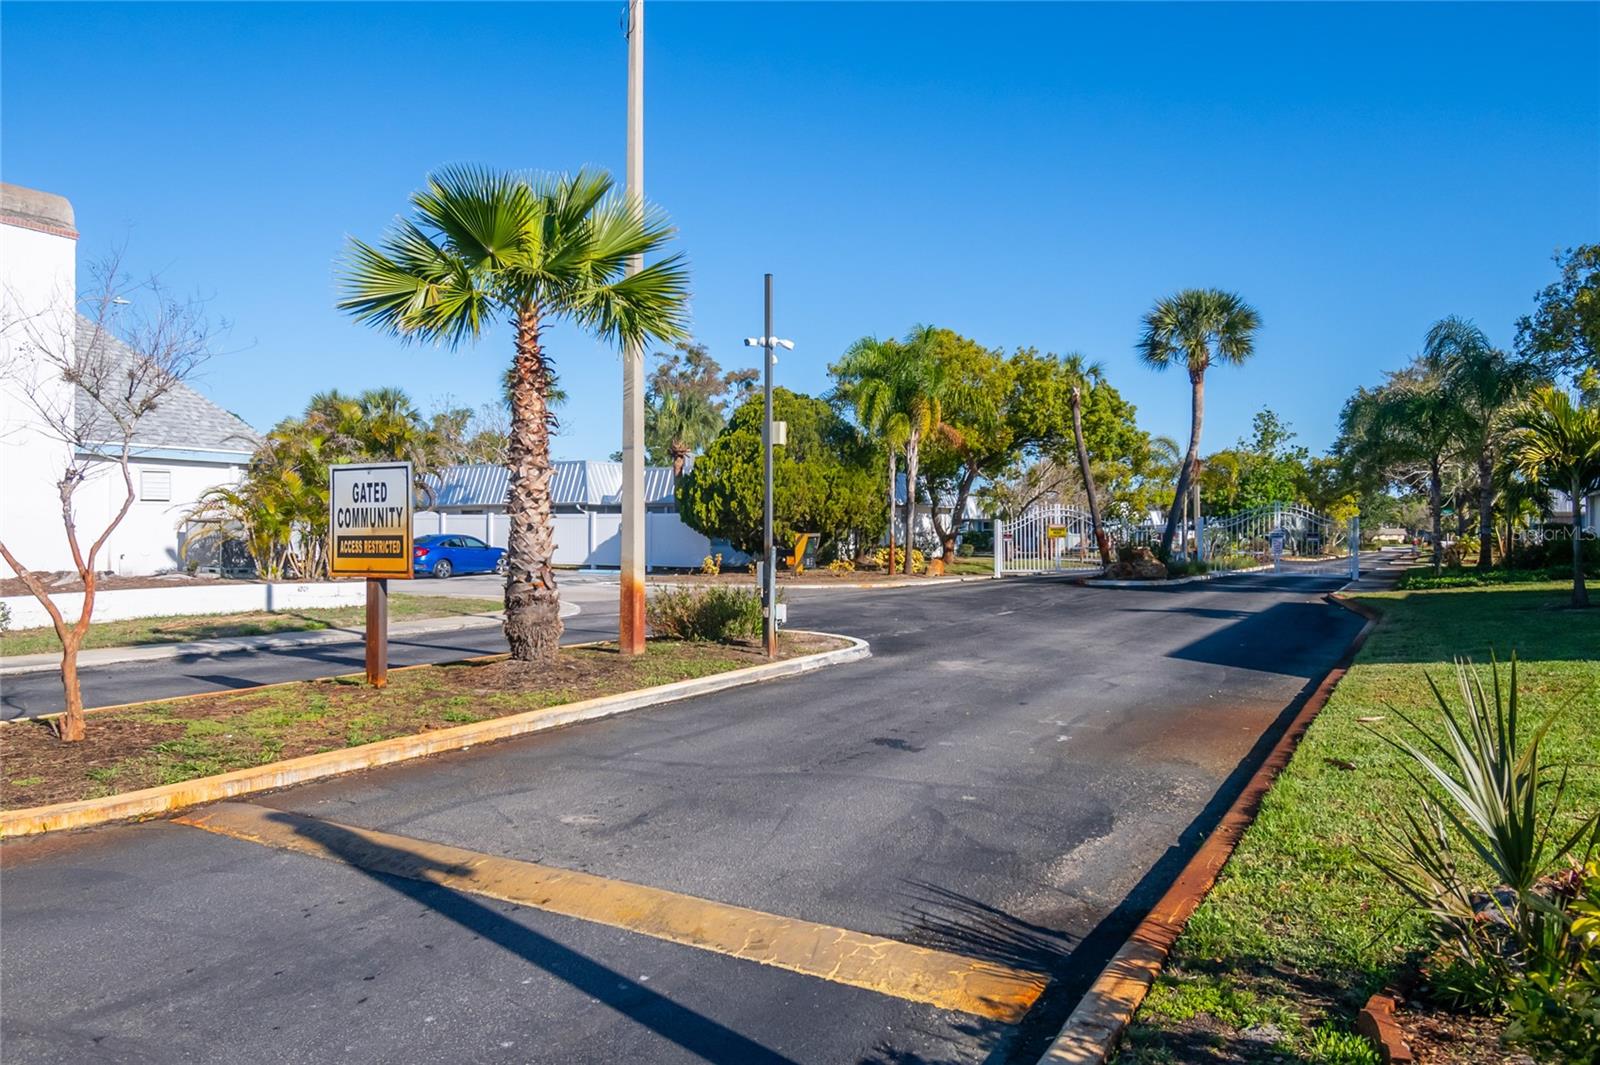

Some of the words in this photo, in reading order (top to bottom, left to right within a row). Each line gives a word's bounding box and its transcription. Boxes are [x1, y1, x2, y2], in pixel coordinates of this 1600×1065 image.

[353, 482, 387, 503] GATED
[337, 507, 403, 529] COMMUNITY
[340, 540, 363, 554] ACCESS
[364, 540, 401, 554] RESTRICTED
